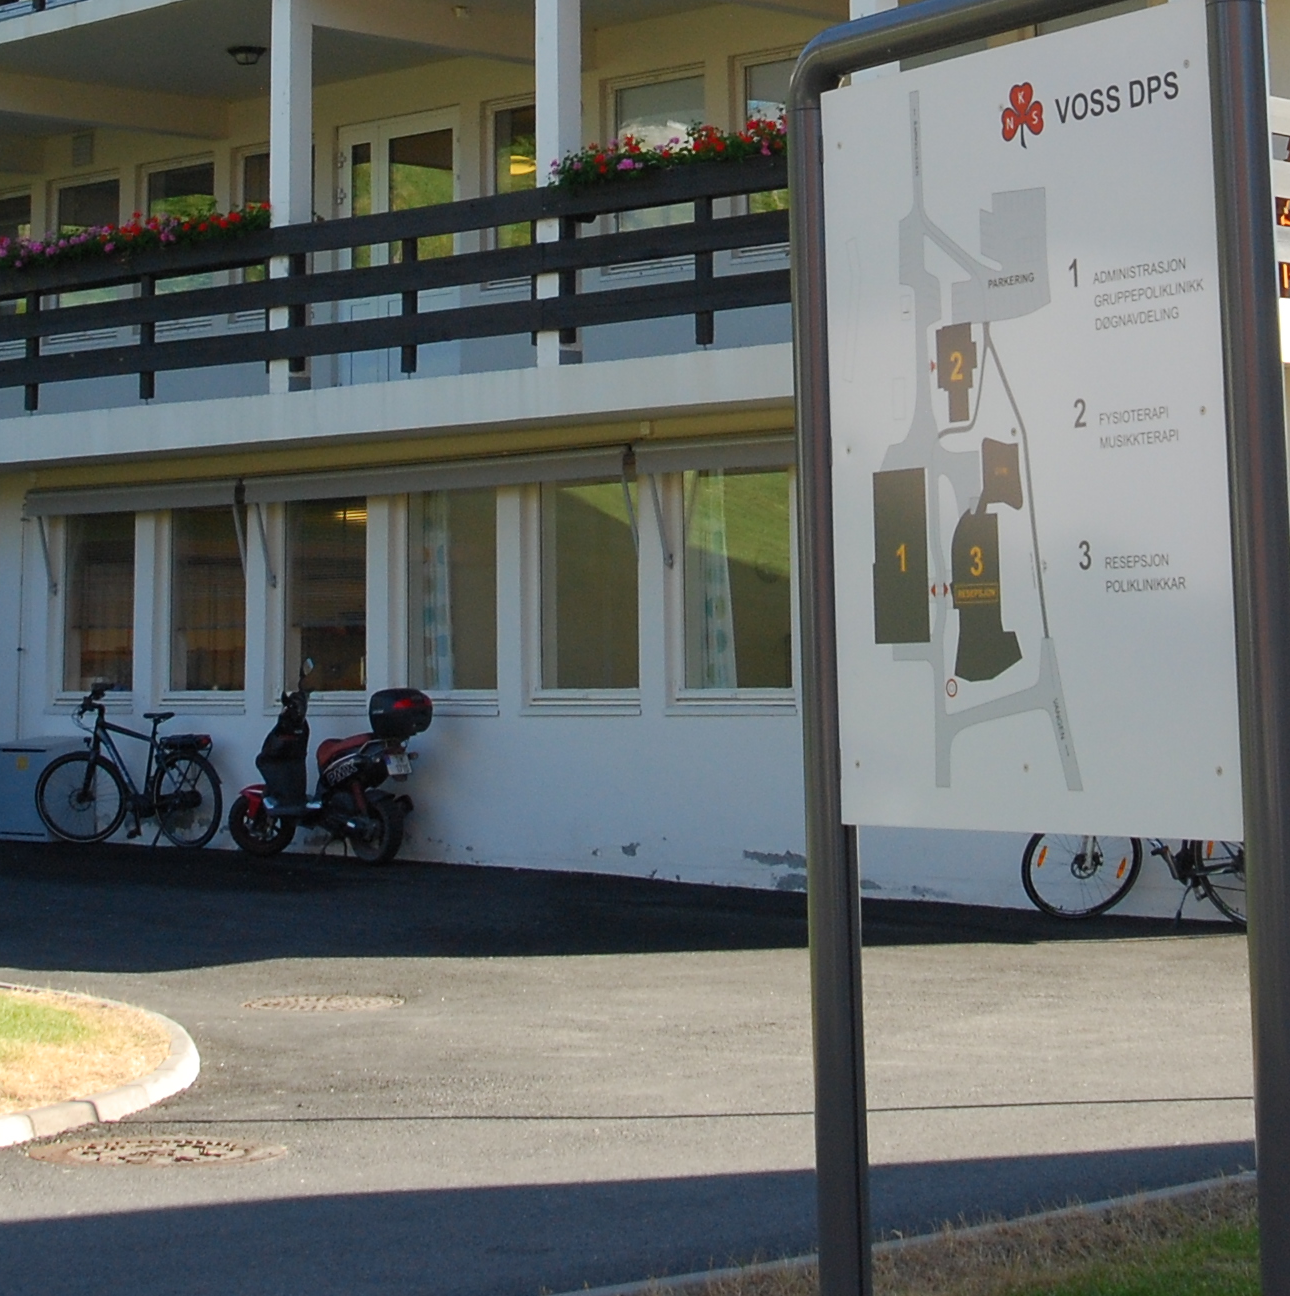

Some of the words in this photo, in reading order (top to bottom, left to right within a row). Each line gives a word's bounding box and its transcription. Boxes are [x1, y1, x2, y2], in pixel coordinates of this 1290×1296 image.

[1006, 118, 1015, 131] N
[1017, 91, 1025, 104] K
[1031, 110, 1039, 124] S
[1055, 85, 1121, 124] VOSS
[1129, 71, 1179, 108] DPS
[987, 272, 1035, 289] PARKERING
[1068, 258, 1078, 288] 1
[1093, 258, 1186, 285] ADMINISTRASJON
[1094, 279, 1204, 308] GRUPPEPOLIKLINIKK
[1095, 306, 1180, 331] DØGNAVDELING
[950, 351, 964, 382] 2
[1073, 398, 1087, 429] 2
[1099, 406, 1169, 426] FYSIOTERAPI
[1099, 429, 1180, 449] MUSIKKTERAPI
[896, 543, 907, 573] 1
[970, 545, 984, 577] 3
[1079, 540, 1092, 570] 3
[1105, 553, 1170, 570] RESEPSJON
[1105, 576, 1186, 593] POLIKLINIKKAR
